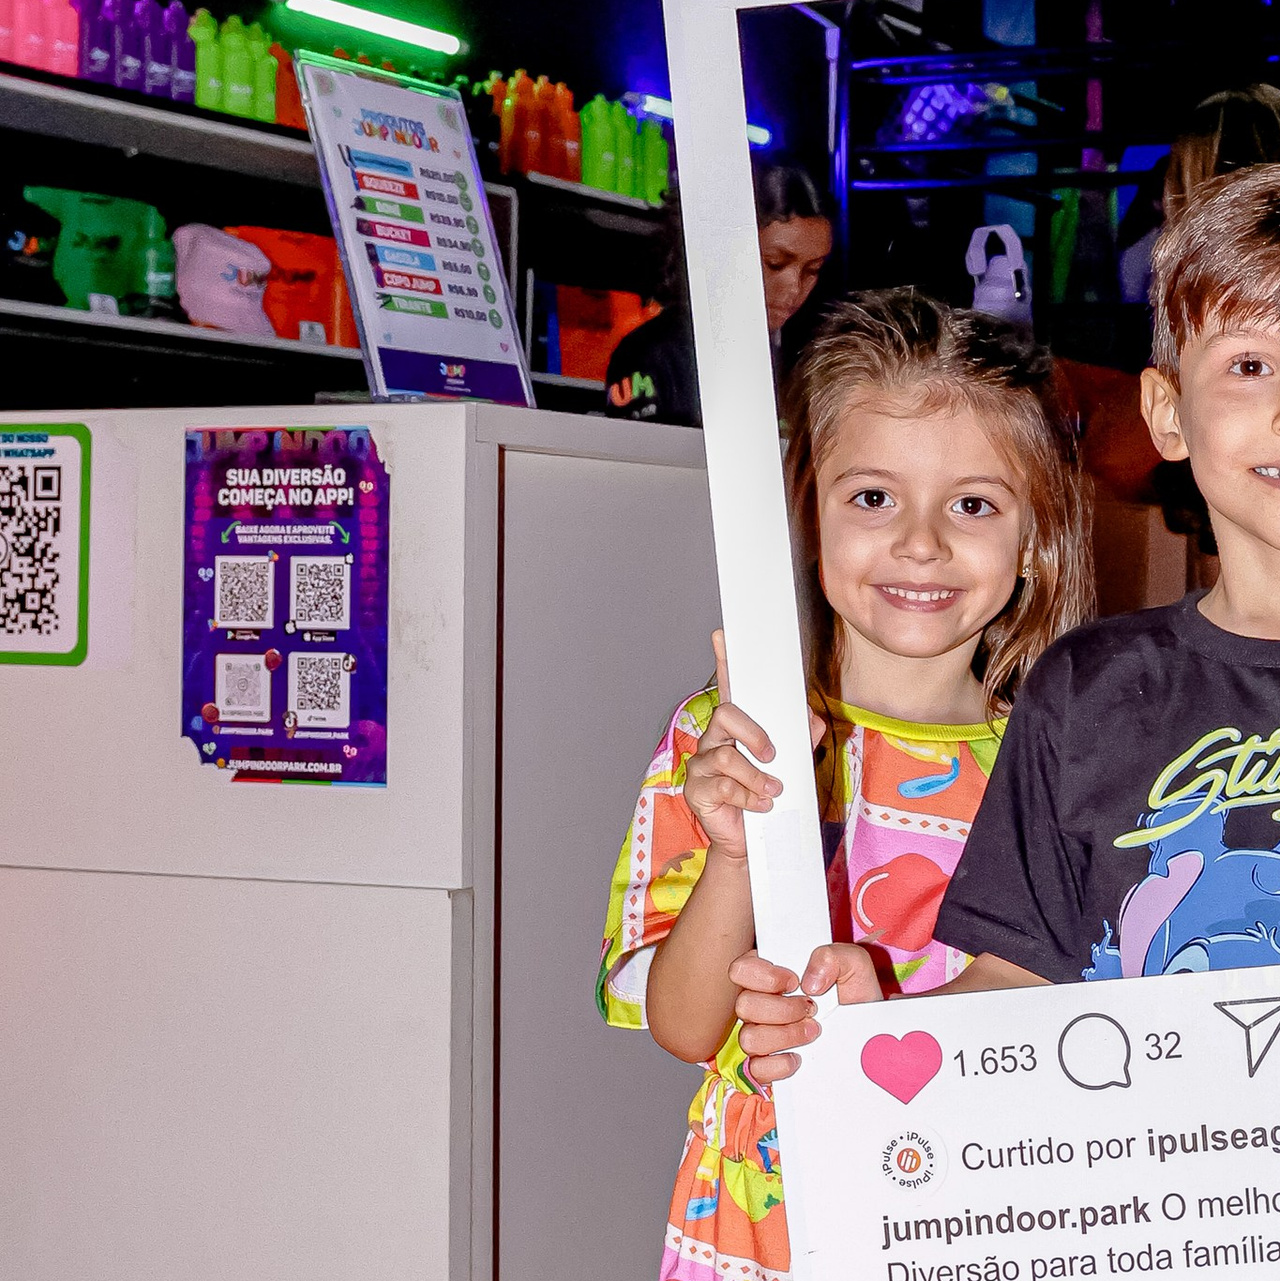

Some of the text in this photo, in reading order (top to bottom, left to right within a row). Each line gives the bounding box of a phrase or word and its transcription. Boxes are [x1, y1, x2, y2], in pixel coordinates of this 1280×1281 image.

[225, 463, 346, 487] SUA DIVERSÃO
[217, 487, 355, 510] COMEÇA NO APP!
[953, 1043, 1038, 1078] 1.653
[1144, 1030, 1183, 1061] 32
[906, 1131, 935, 1160] iPulse
[961, 1137, 1075, 1171] Curtido
[1086, 1137, 1137, 1168] por
[881, 1196, 1151, 1250] jumpindoor.park
[1161, 1192, 1187, 1221] O
[1106, 1243, 1174, 1274] toda
